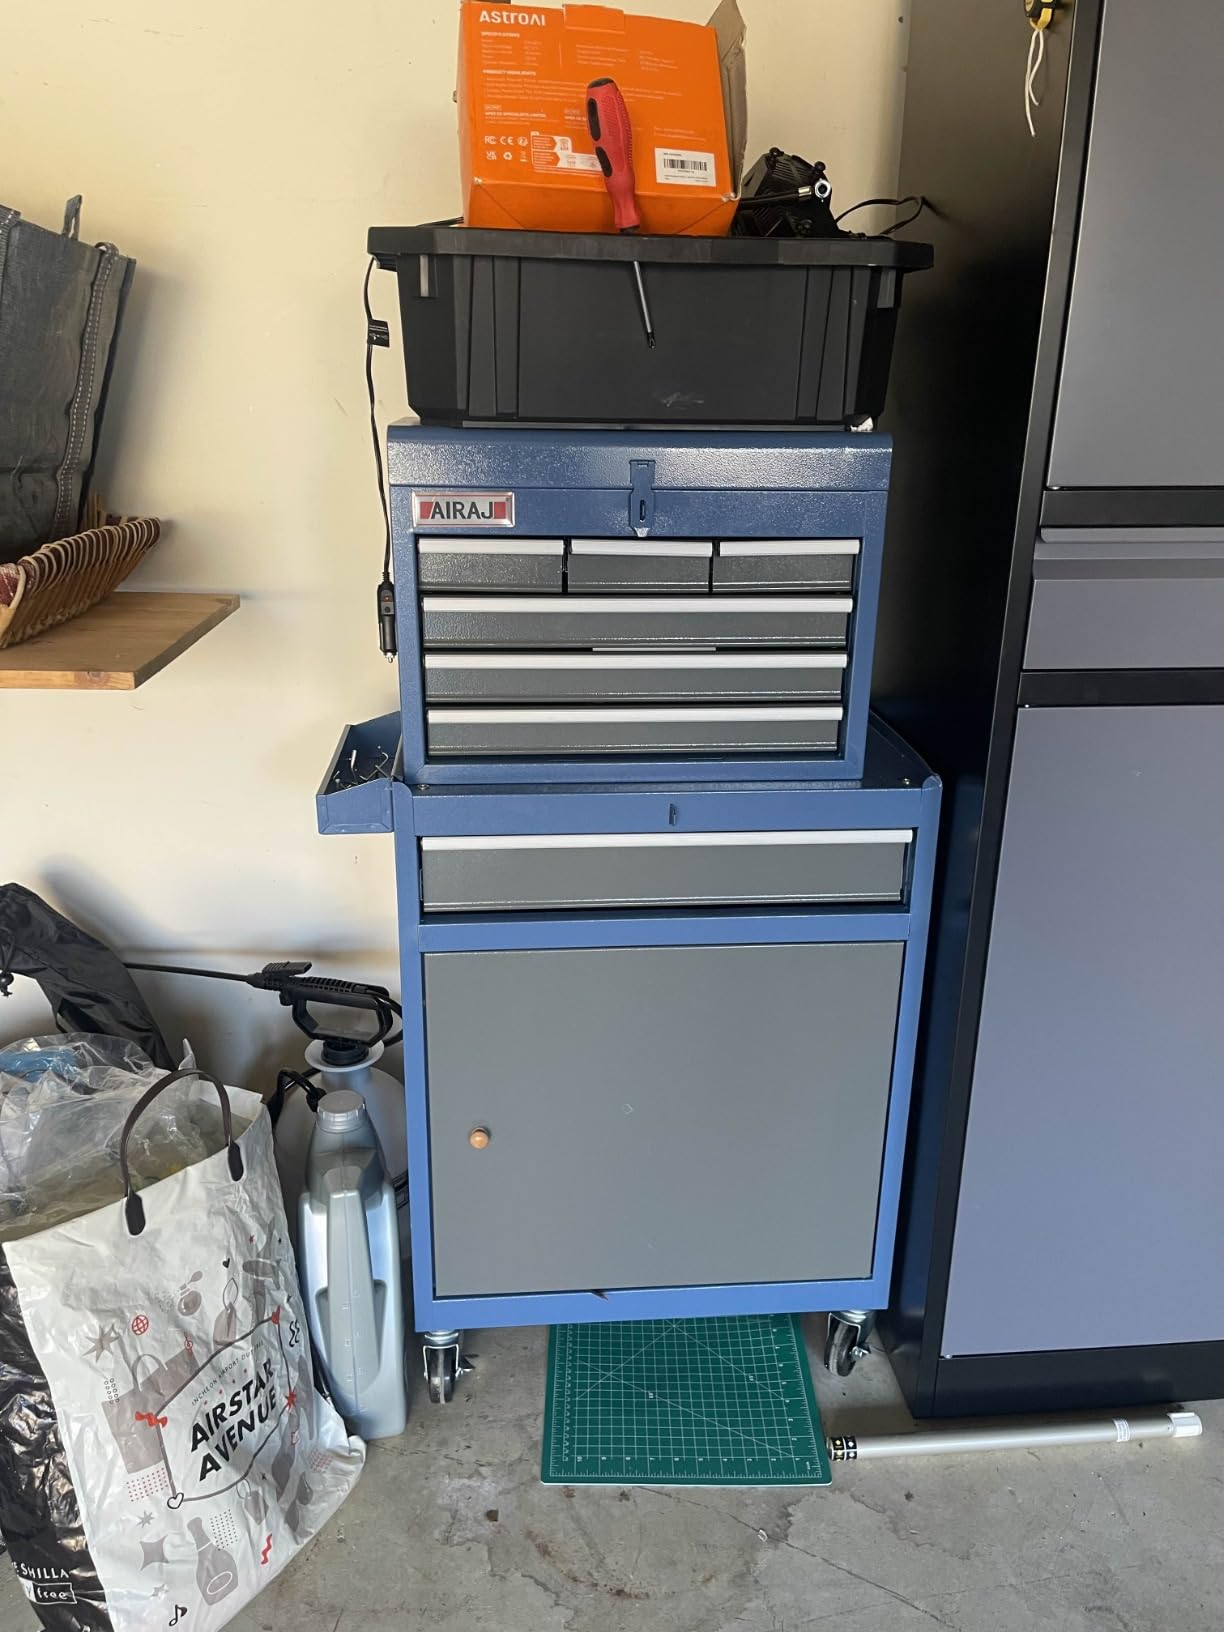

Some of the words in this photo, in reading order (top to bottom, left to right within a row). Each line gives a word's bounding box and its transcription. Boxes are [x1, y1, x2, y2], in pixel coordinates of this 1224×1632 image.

[431, 501, 494, 520] AIRAJ
[190, 1357, 274, 1453] AIRSTAR
[199, 1384, 277, 1482] AVENUE
[20, 1563, 69, 1579] SHILLA
[37, 1587, 68, 1600] free
